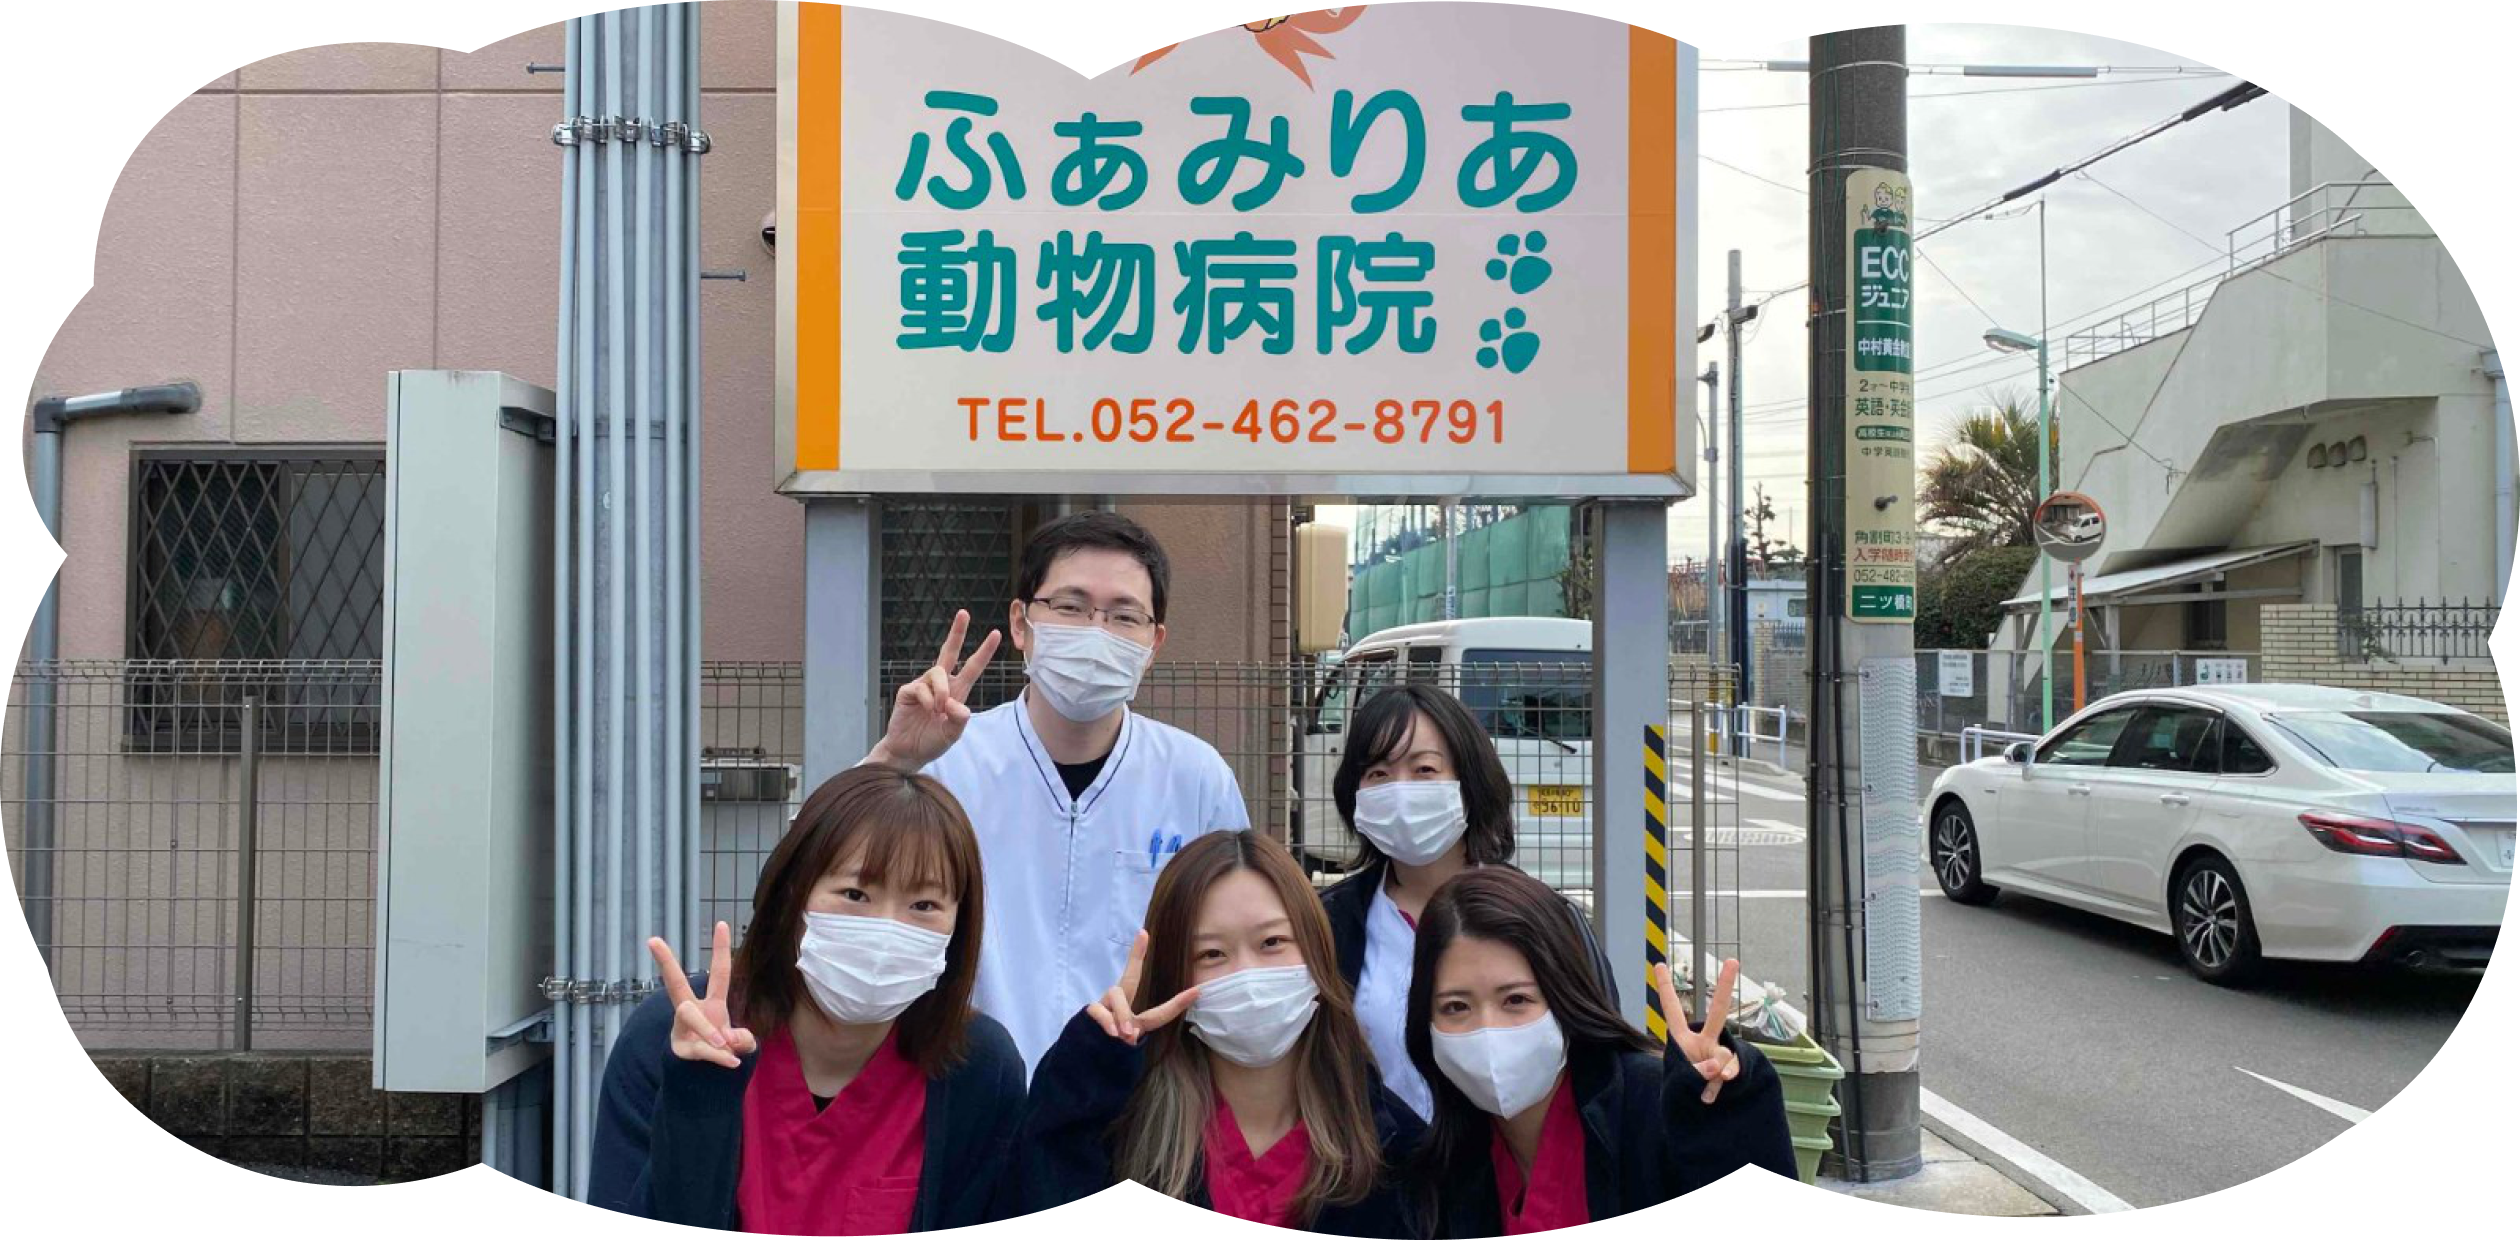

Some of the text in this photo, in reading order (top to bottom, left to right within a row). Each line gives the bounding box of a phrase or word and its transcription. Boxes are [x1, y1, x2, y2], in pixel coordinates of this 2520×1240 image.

[896, 89, 1577, 212] ふぁみりあ
[896, 229, 1436, 355] 動物病院
[1861, 246, 1910, 282] ECC
[958, 397, 1503, 444] TEL.052-462-8791
